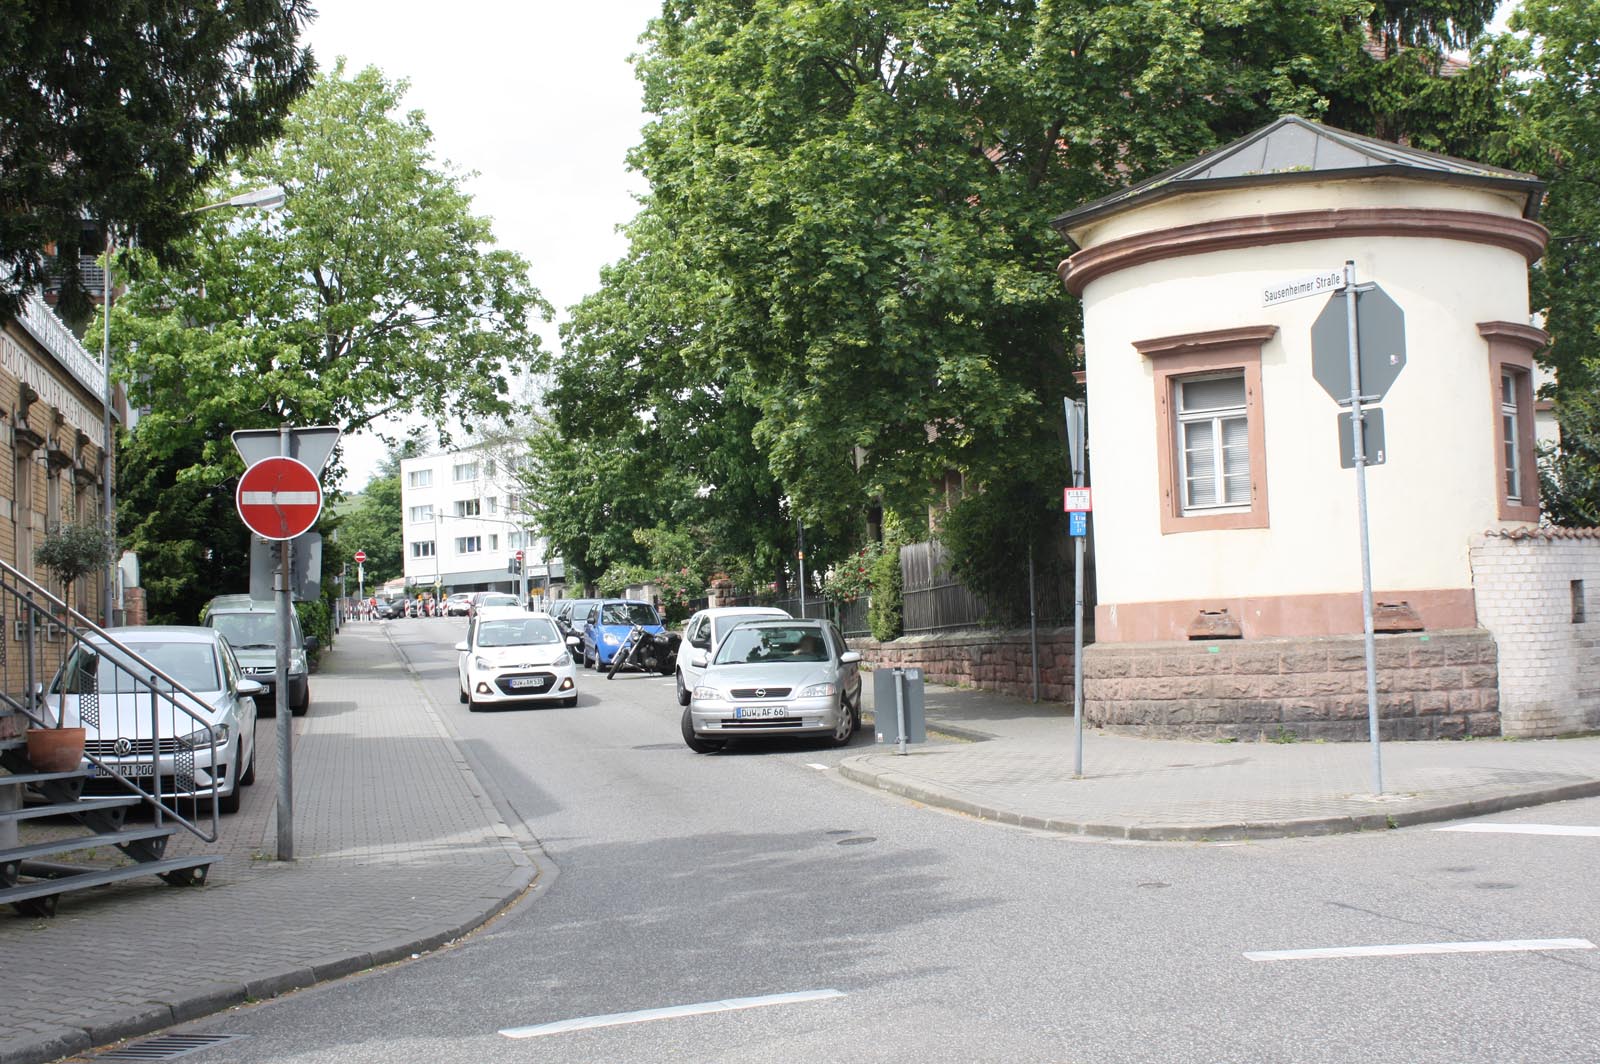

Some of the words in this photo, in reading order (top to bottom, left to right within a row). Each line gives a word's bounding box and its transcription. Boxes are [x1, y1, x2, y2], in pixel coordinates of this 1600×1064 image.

[1264, 280, 1314, 302] Sausenheimer
[1316, 273, 1341, 289] Straße
[1, 336, 29, 384] DRUCK
[30, 360, 48, 397] UND
[762, 708, 773, 717] AF
[774, 707, 784, 716] 66
[121, 765, 133, 777] RI
[135, 764, 154, 776] 200
